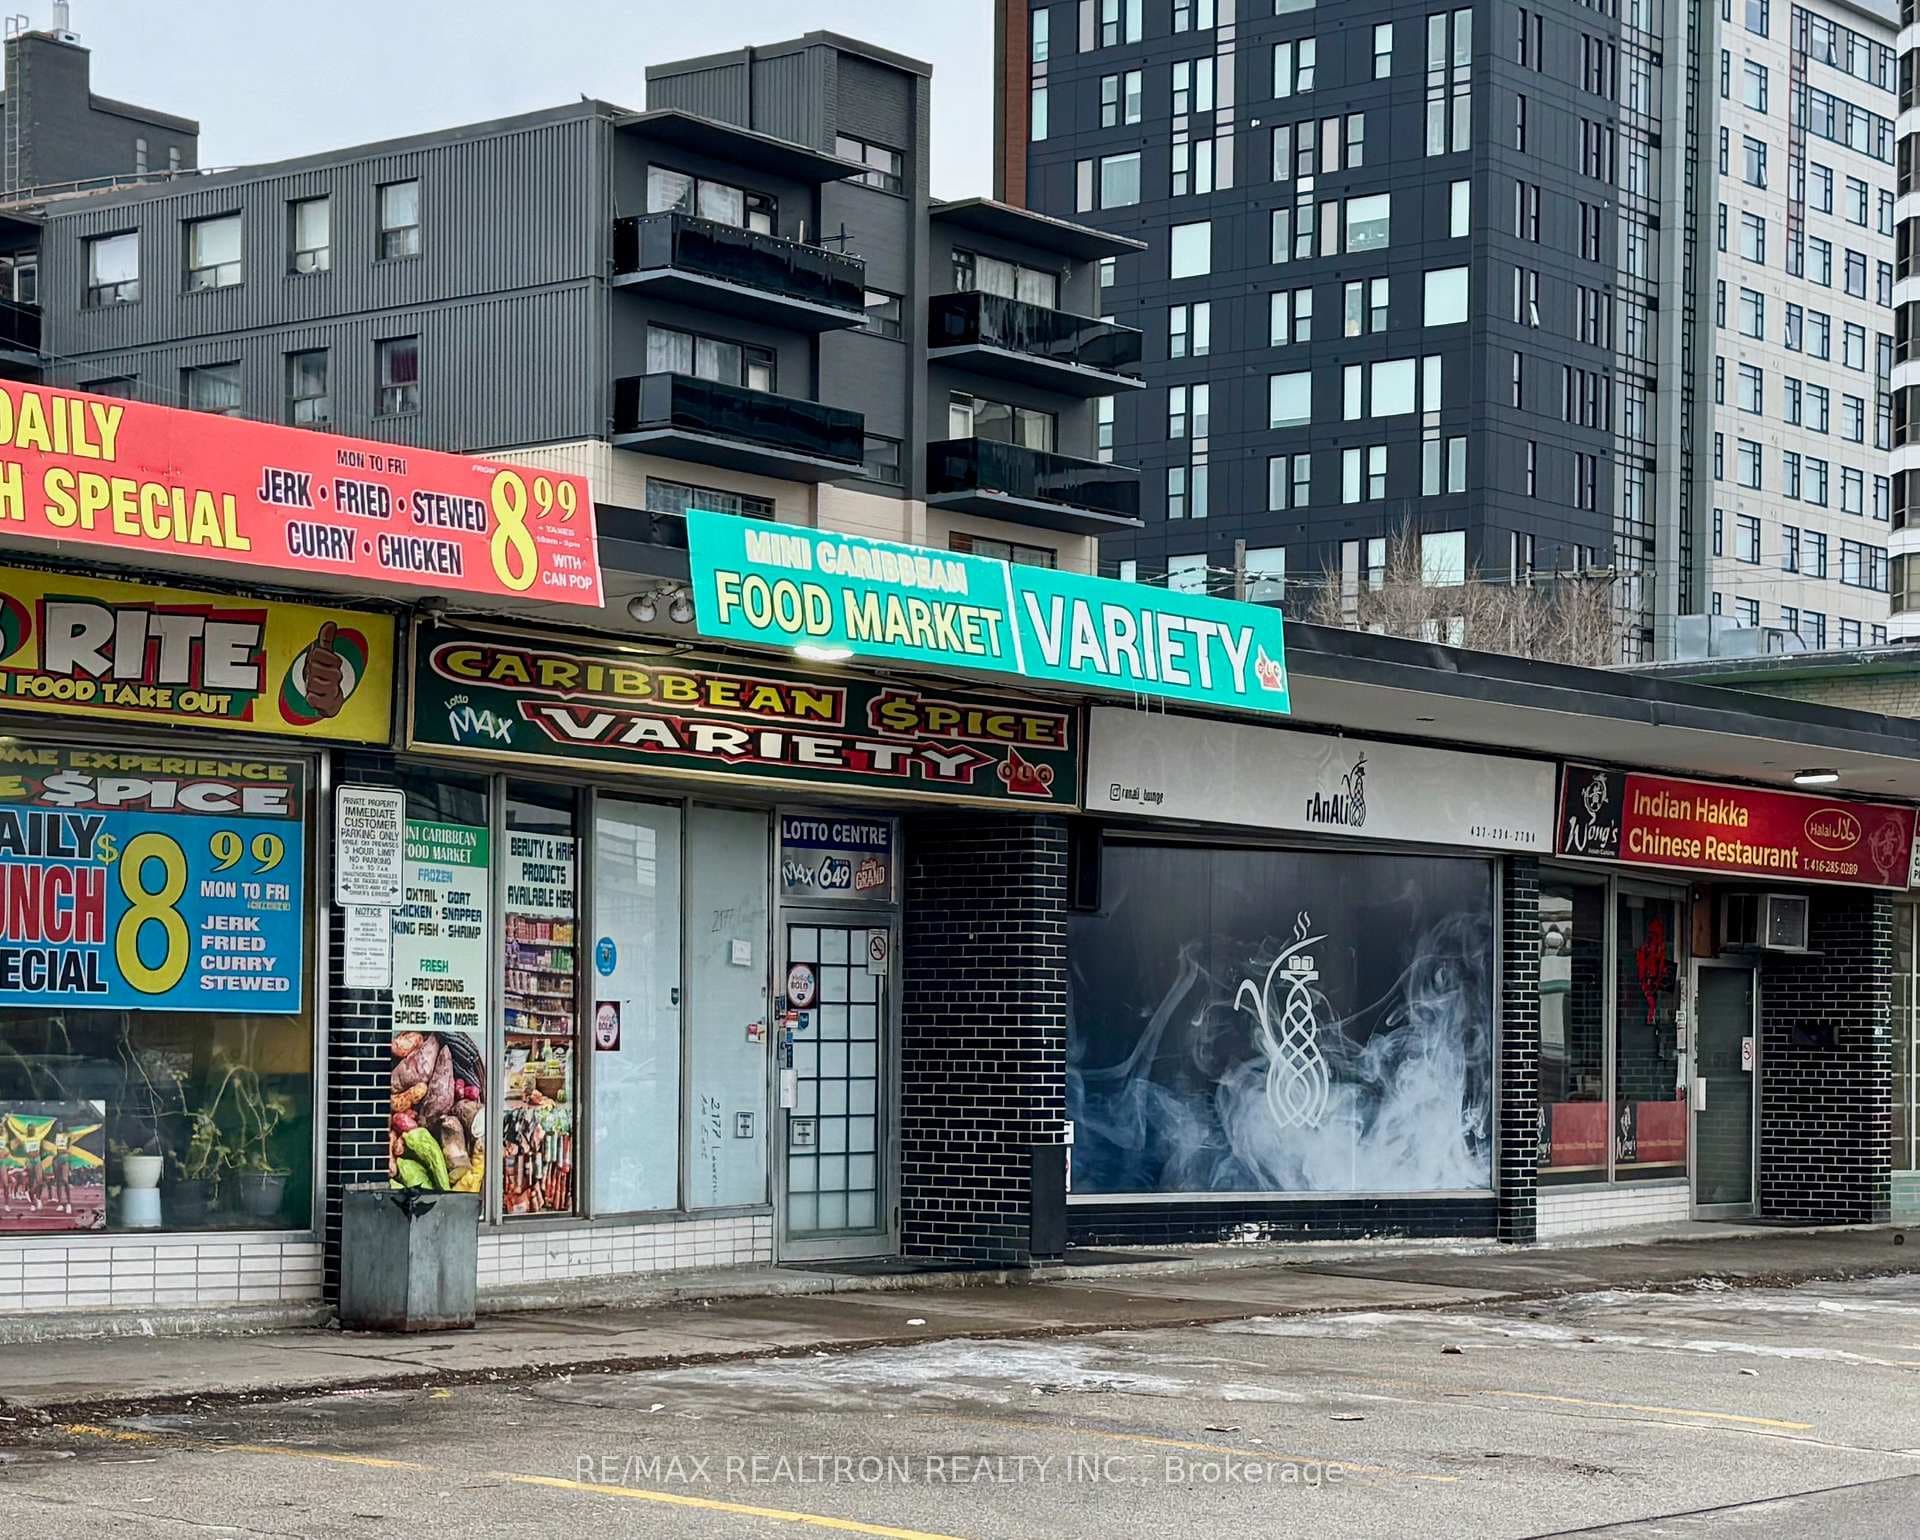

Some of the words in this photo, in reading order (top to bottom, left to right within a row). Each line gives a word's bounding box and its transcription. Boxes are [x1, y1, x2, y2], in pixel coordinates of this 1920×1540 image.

[337, 449, 364, 468] MON
[368, 455, 383, 472] TO
[388, 458, 407, 475] FRI
[43, 466, 251, 551] SPECIAL
[258, 467, 313, 508] JERK
[334, 478, 391, 519] FRIED
[413, 490, 487, 532] STEWED
[490, 468, 539, 591] 8
[533, 475, 578, 523] 99
[287, 521, 356, 561] CURRY
[377, 533, 463, 576] CHICKEN
[552, 553, 582, 570] WITH
[745, 528, 812, 571] MINI
[816, 540, 969, 596] CARIBBEAN
[543, 571, 567, 587] CAN
[569, 575, 592, 590] POP
[714, 569, 833, 637] FOOD
[842, 587, 1003, 658] MARKET
[45, 601, 261, 690] RITE
[1021, 590, 1254, 694] VARIETY
[16, 674, 97, 701] FOOD
[102, 683, 173, 708] TAKE
[179, 691, 231, 714] OUT
[446, 650, 834, 718] CARIBBEAN
[449, 706, 513, 744] MAX
[541, 707, 976, 777] VARIETY
[70, 751, 288, 780] EXPERIENCE
[998, 761, 1053, 786] OLG
[345, 806, 396, 820] IMMEDIATE
[367, 799, 398, 808] PROPERTY
[1633, 789, 1691, 820] Indian
[1695, 796, 1749, 828] Hakka
[341, 827, 376, 840] PARKING
[379, 830, 400, 841] ONLY
[344, 816, 397, 830] CUSTOMER
[783, 820, 828, 841] LOTTO
[832, 824, 887, 845] CENTRE
[1810, 822, 1832, 838] Halal
[405, 825, 420, 842] INI
[422, 827, 477, 847] CARIBBEAN
[1564, 816, 1619, 853] Wong's
[208, 830, 285, 875] 99
[352, 846, 375, 856] HOUR
[377, 848, 396, 857] LIMIT
[433, 846, 472, 863] MARKET
[511, 836, 545, 859] BEAUTY
[546, 840, 554, 860] &
[1628, 827, 1701, 859] Chinese
[1704, 835, 1799, 869] Restaurant
[349, 855, 360, 863] NO
[362, 856, 391, 866] PARKING
[418, 868, 453, 883] FROZEN
[522, 862, 566, 885] PRODUCTS
[782, 860, 815, 888] MAX
[855, 866, 886, 891] GRAND
[201, 880, 236, 898] MON
[241, 883, 260, 899] TO
[265, 883, 289, 901] FRI
[406, 887, 438, 902] OXTAIL
[447, 891, 471, 905] GOAT
[507, 885, 554, 907] AVAILABLE
[355, 907, 381, 917] NOTICE
[442, 907, 482, 922] SNAPPER
[201, 915, 260, 932] JERK
[394, 921, 415, 935] KING
[418, 922, 439, 936] FISH
[448, 925, 481, 939] SHRIMP
[201, 935, 266, 951] FRIED
[200, 955, 277, 972] CURRY
[420, 959, 449, 973] FRESH
[200, 975, 290, 992] STEWED
[411, 978, 465, 993] PROVISIONS
[398, 994, 424, 1008] YAMS
[434, 996, 476, 1010] BANANAS
[394, 1011, 427, 1024] SPICES
[433, 1012, 452, 1025] AND
[454, 1013, 479, 1026] MORE
